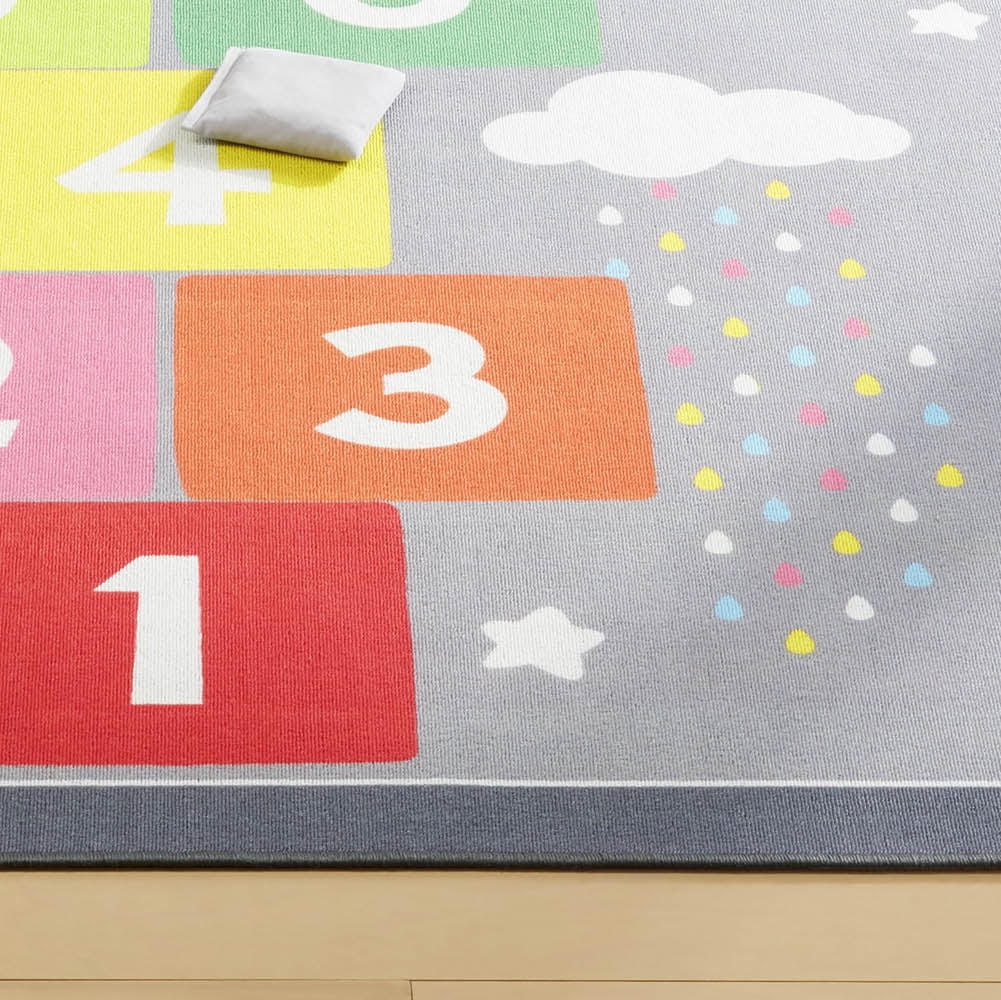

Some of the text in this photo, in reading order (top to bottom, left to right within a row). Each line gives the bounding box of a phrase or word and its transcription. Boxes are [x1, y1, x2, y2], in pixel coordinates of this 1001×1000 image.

[55, 109, 273, 226] 4
[315, 321, 509, 450] 3
[93, 555, 204, 706] 1
